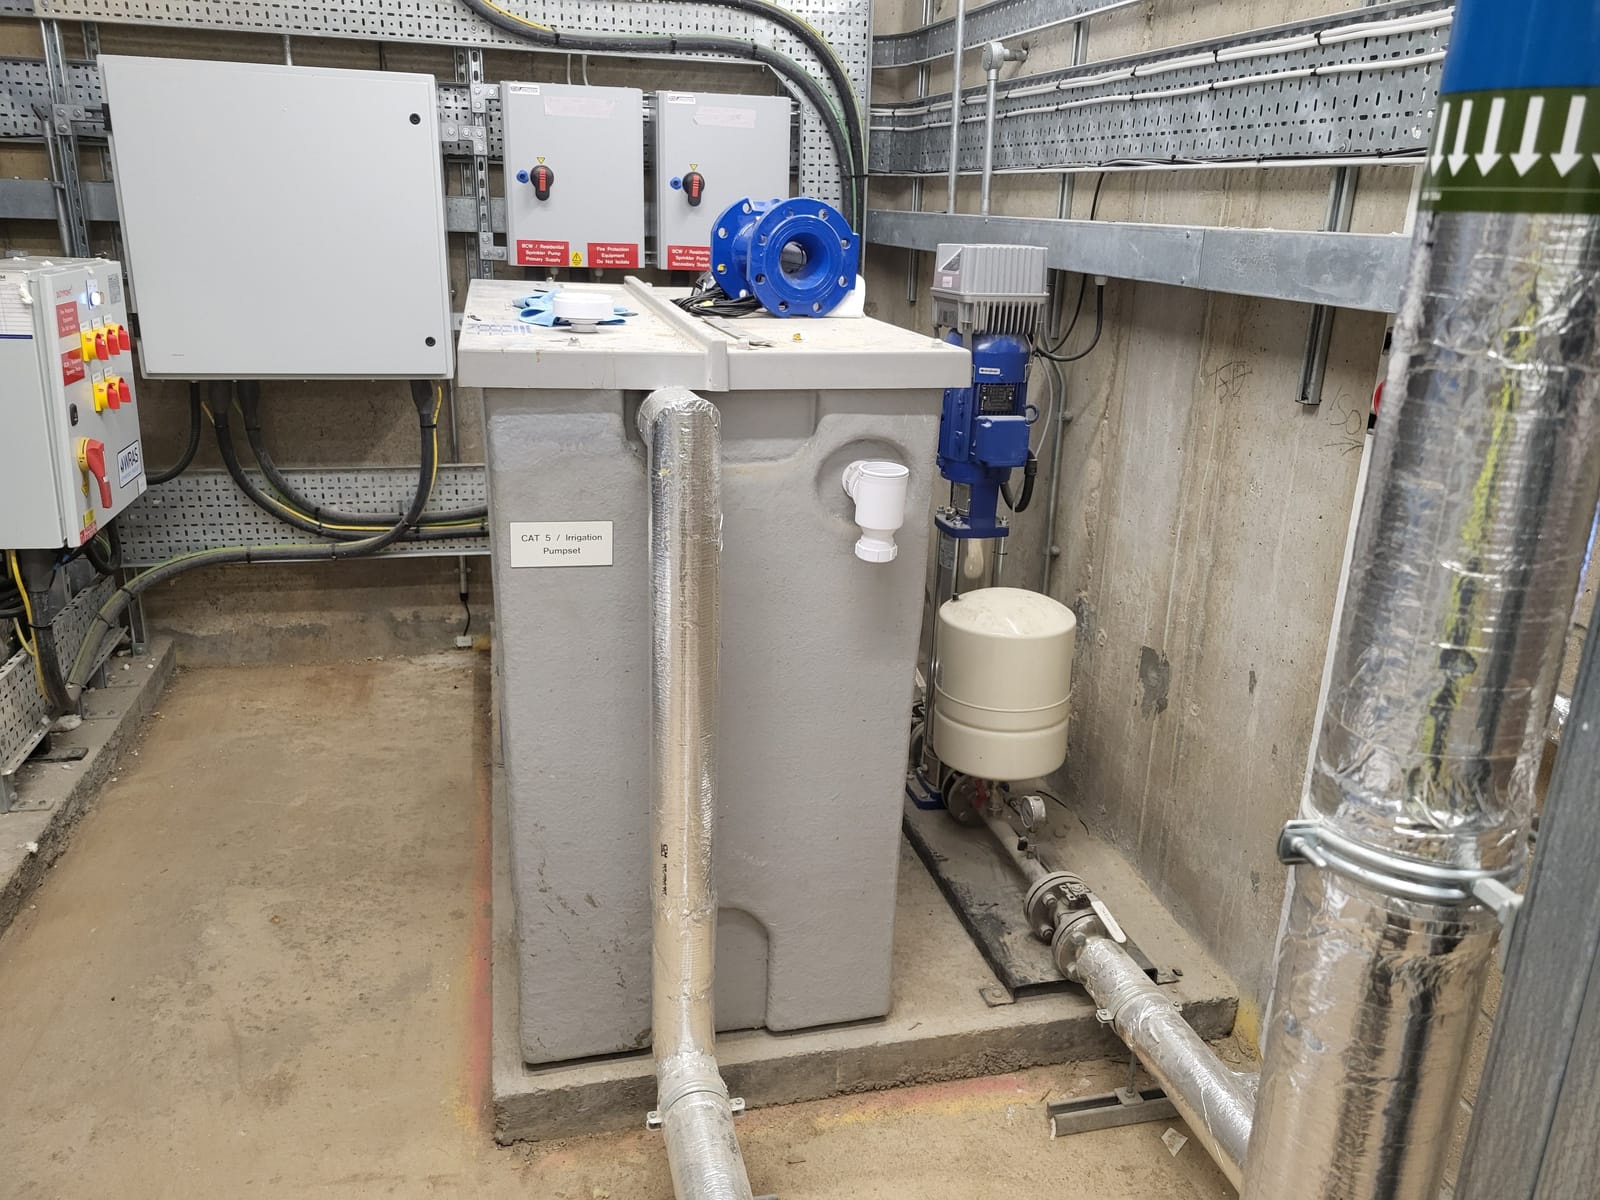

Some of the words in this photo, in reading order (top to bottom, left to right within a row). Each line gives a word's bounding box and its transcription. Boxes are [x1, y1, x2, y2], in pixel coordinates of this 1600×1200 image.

[521, 534, 540, 542] CAT
[545, 534, 551, 542] 5
[565, 533, 603, 542] Irrigation
[543, 547, 581, 555] Pumpset
